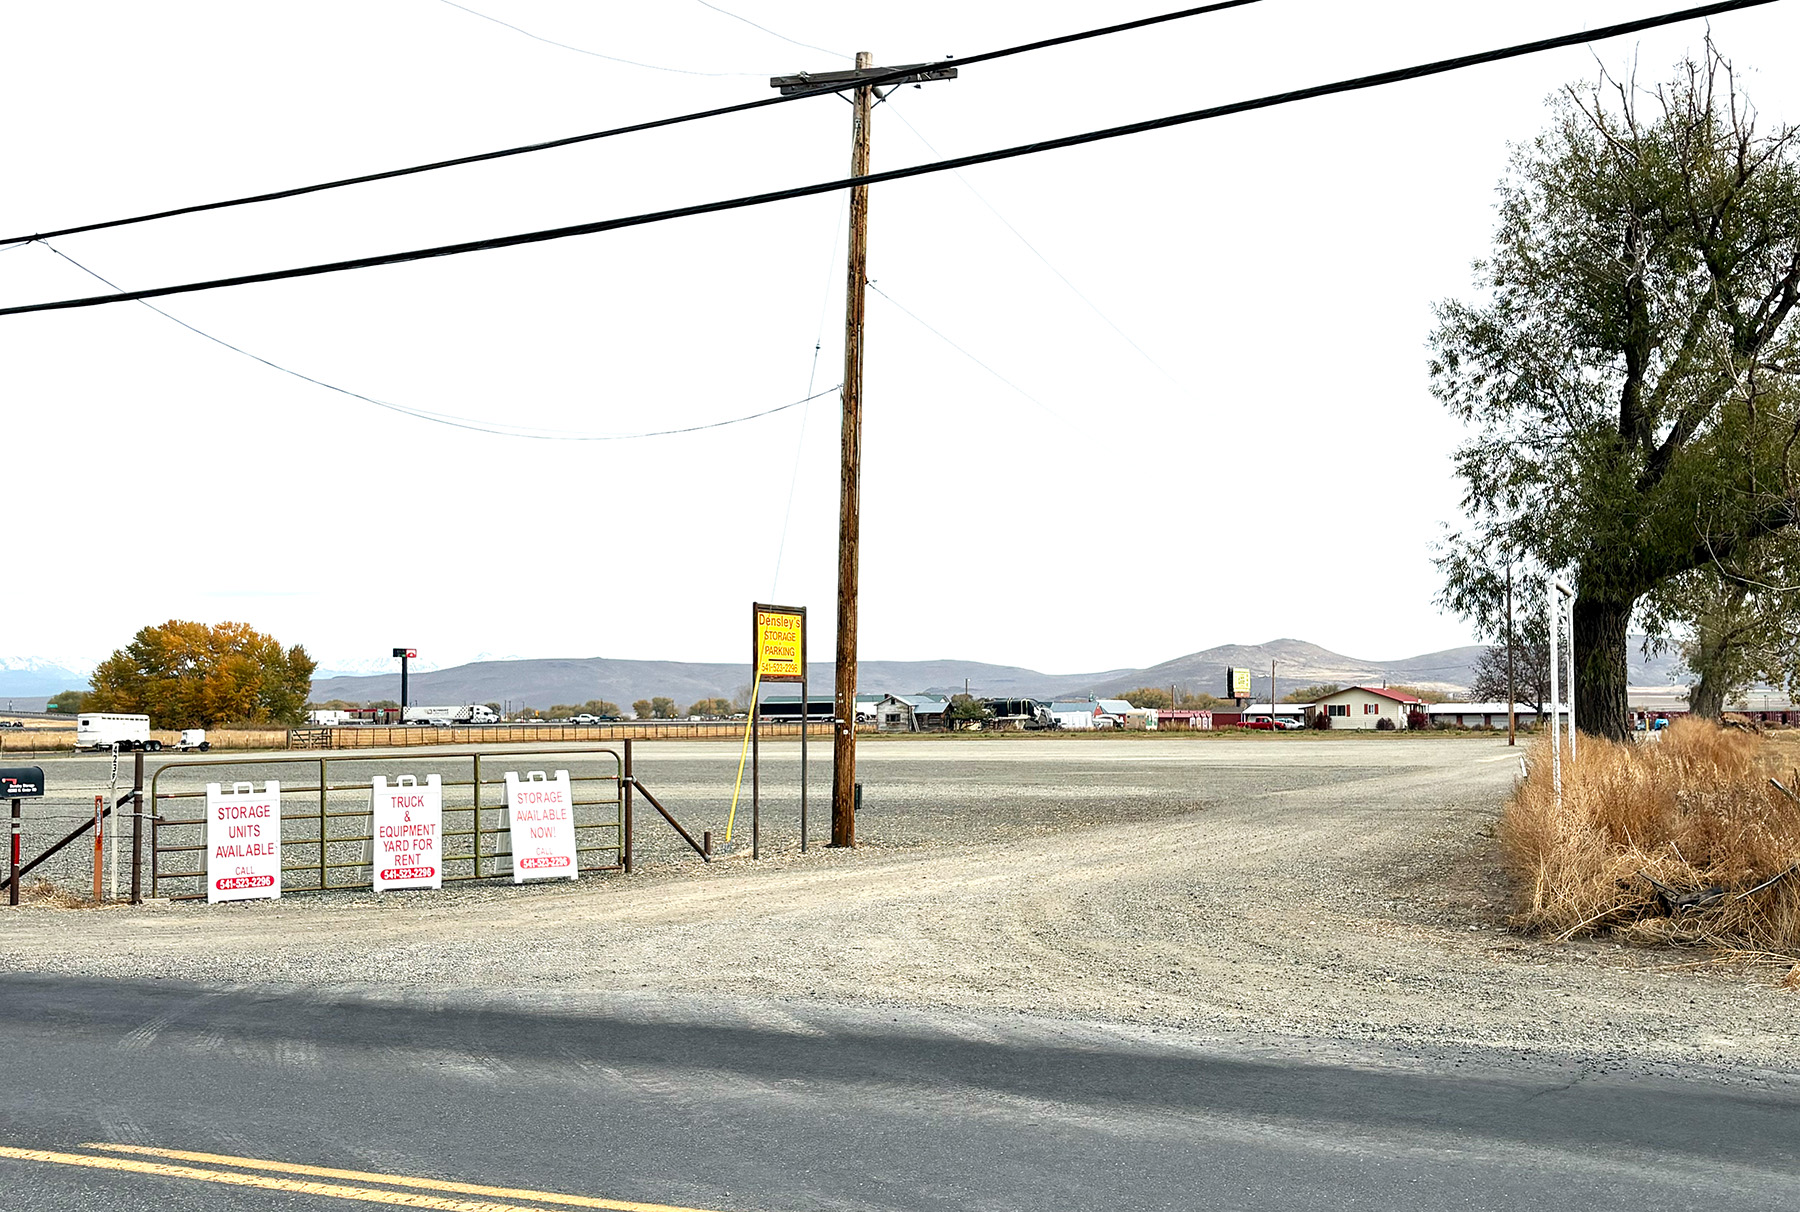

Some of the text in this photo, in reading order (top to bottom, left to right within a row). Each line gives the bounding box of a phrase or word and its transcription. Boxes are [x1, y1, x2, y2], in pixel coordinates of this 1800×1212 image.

[759, 613, 801, 630] Densley's
[764, 630, 796, 642] STORAGE
[764, 645, 795, 657] PARKING
[761, 662, 798, 673] 541-523-2296
[391, 795, 425, 808] TRUCK
[517, 791, 563, 804] STORAGE
[217, 804, 271, 820] STORAGE
[404, 810, 411, 822] &
[516, 808, 567, 821] AVAILABLE
[228, 824, 261, 838] UNITS
[379, 823, 436, 838] EQUIPMENT
[530, 826, 557, 839] NOW!
[216, 842, 275, 859] AVAILABLE
[383, 838, 433, 852] YARD FOR
[536, 847, 553, 856] CALL
[394, 853, 421, 866] RENT
[522, 857, 568, 868] 541-523-2296
[235, 866, 255, 875] CALL
[383, 867, 432, 880] 541-523-2296
[219, 876, 271, 889] 541-523-2296
